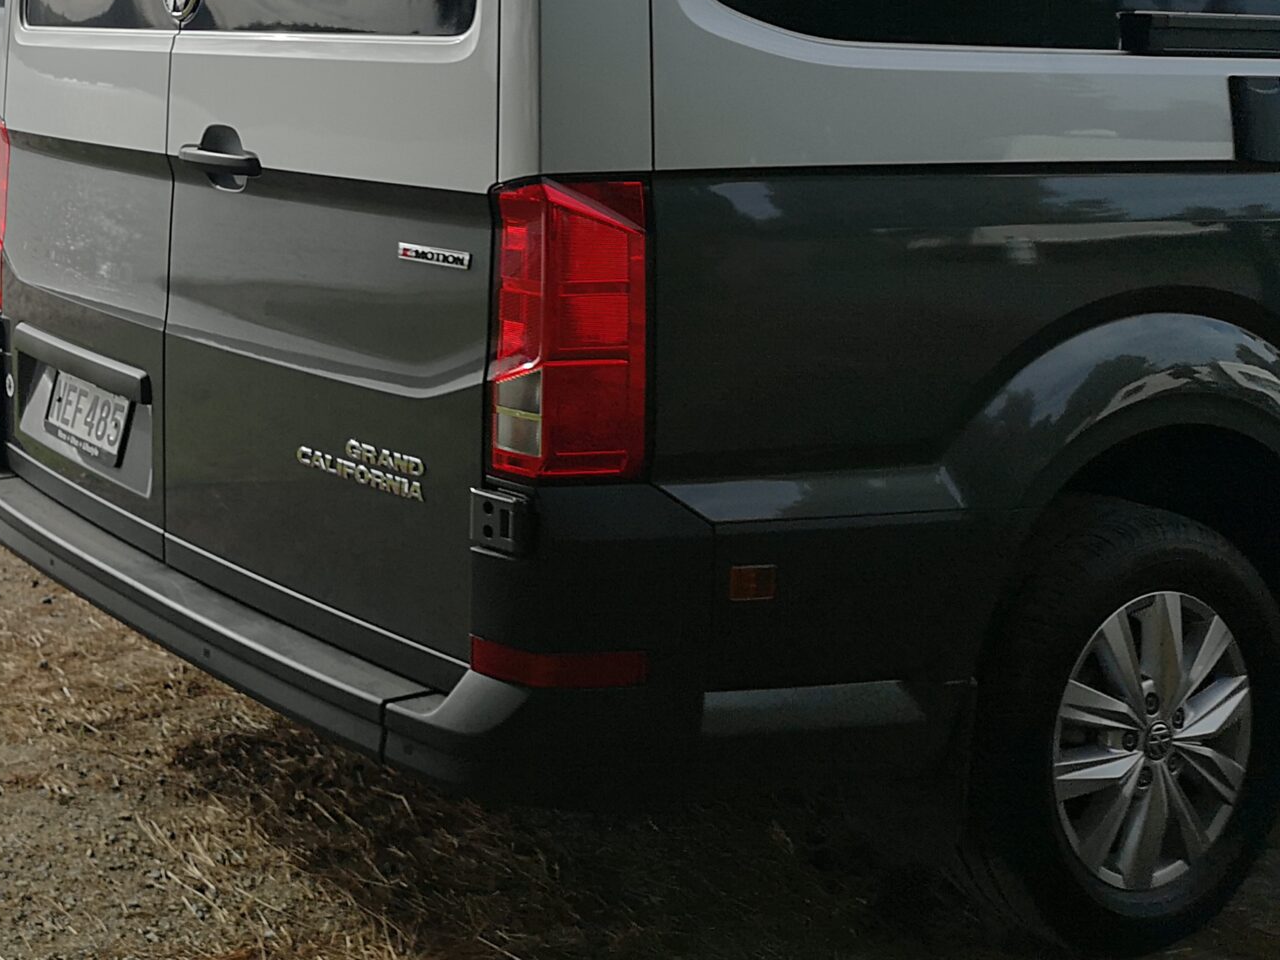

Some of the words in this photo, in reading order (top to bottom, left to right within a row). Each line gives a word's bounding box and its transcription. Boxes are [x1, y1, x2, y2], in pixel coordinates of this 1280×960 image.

[50, 377, 125, 447] NEF485
[296, 445, 424, 502] CALIFORNIA
[345, 438, 425, 477] GRAND
